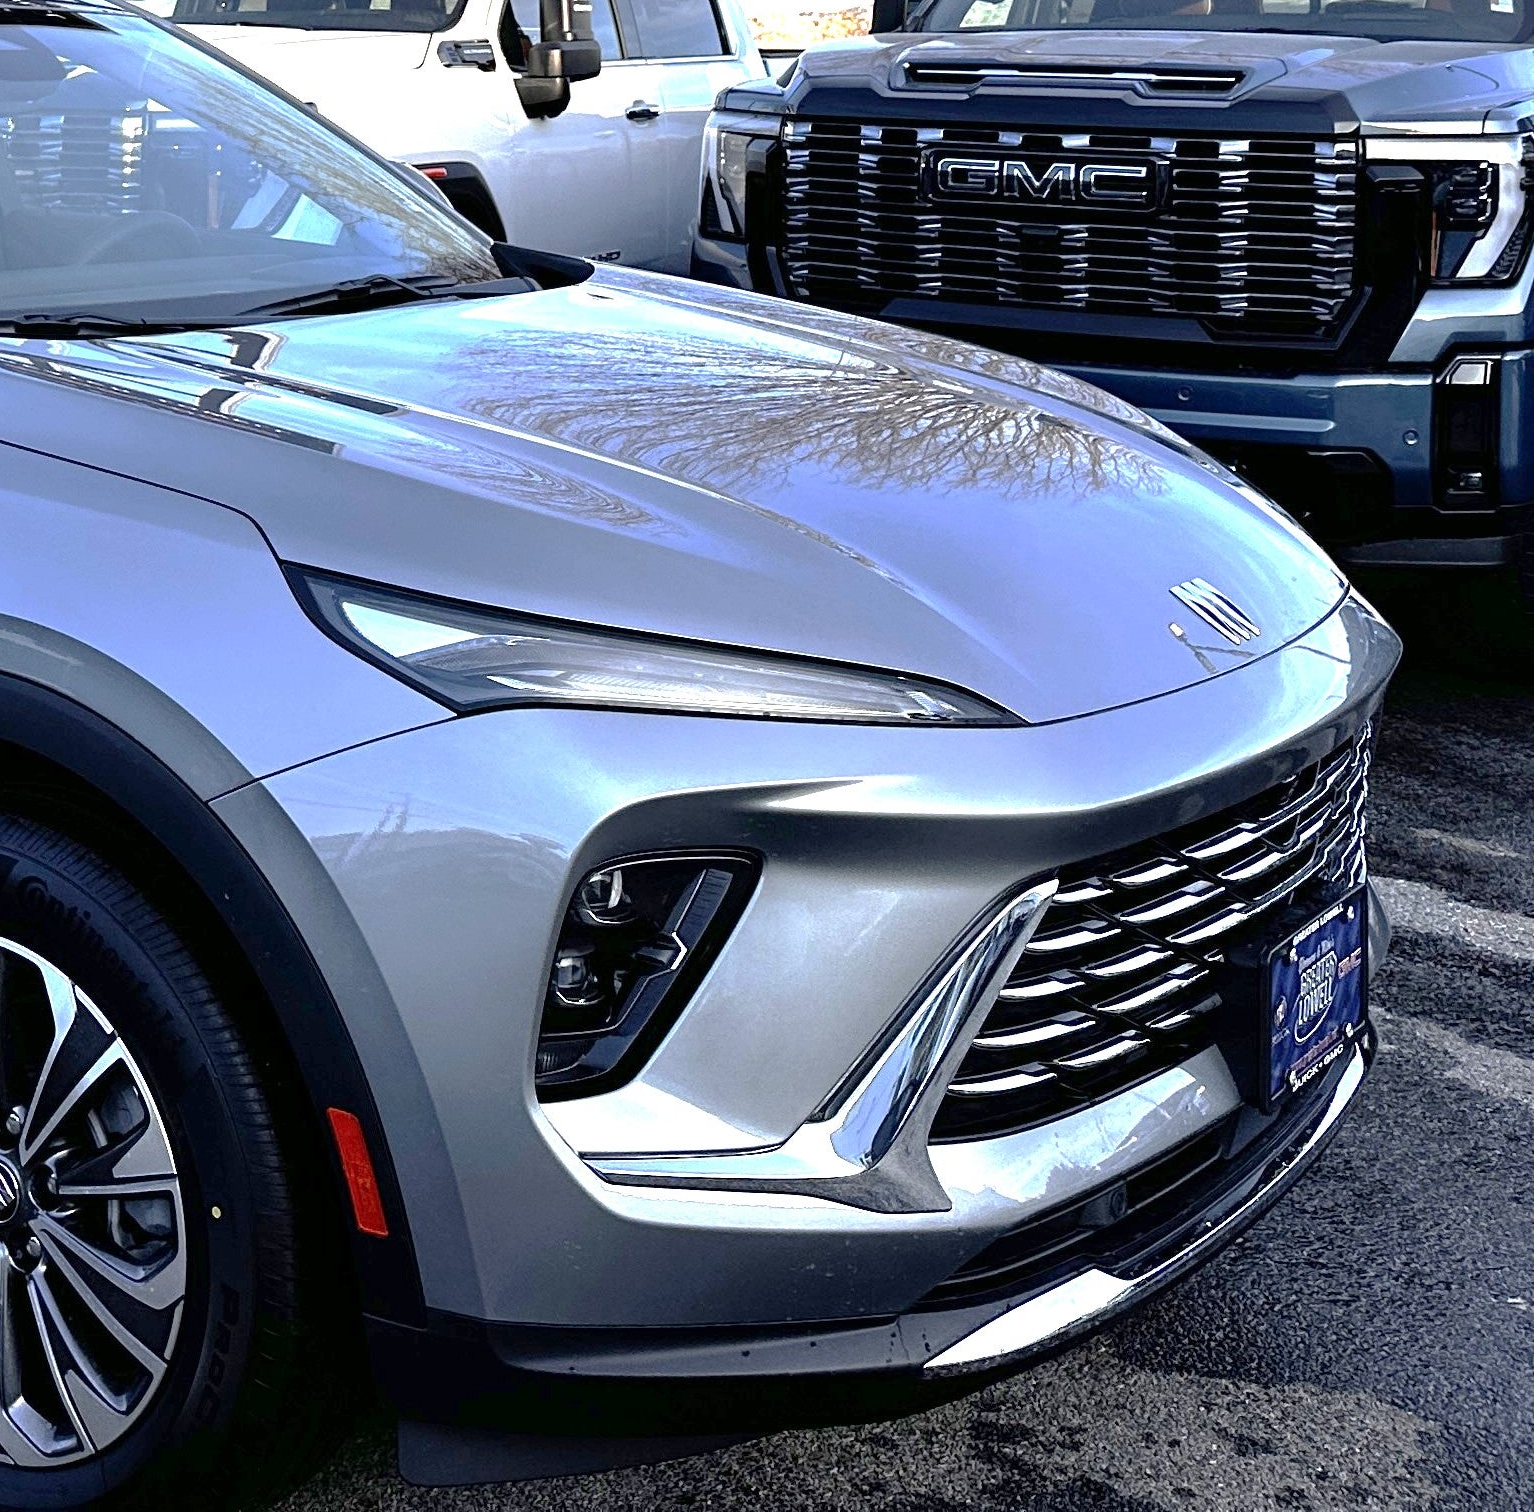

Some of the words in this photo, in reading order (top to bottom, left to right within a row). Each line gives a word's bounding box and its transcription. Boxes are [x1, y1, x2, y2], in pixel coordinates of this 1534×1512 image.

[938, 158, 1147, 202] GMC
[1300, 953, 1337, 996] GREATER
[1298, 977, 1333, 1025] LOWELL
[1324, 1043, 1344, 1066] GMC
